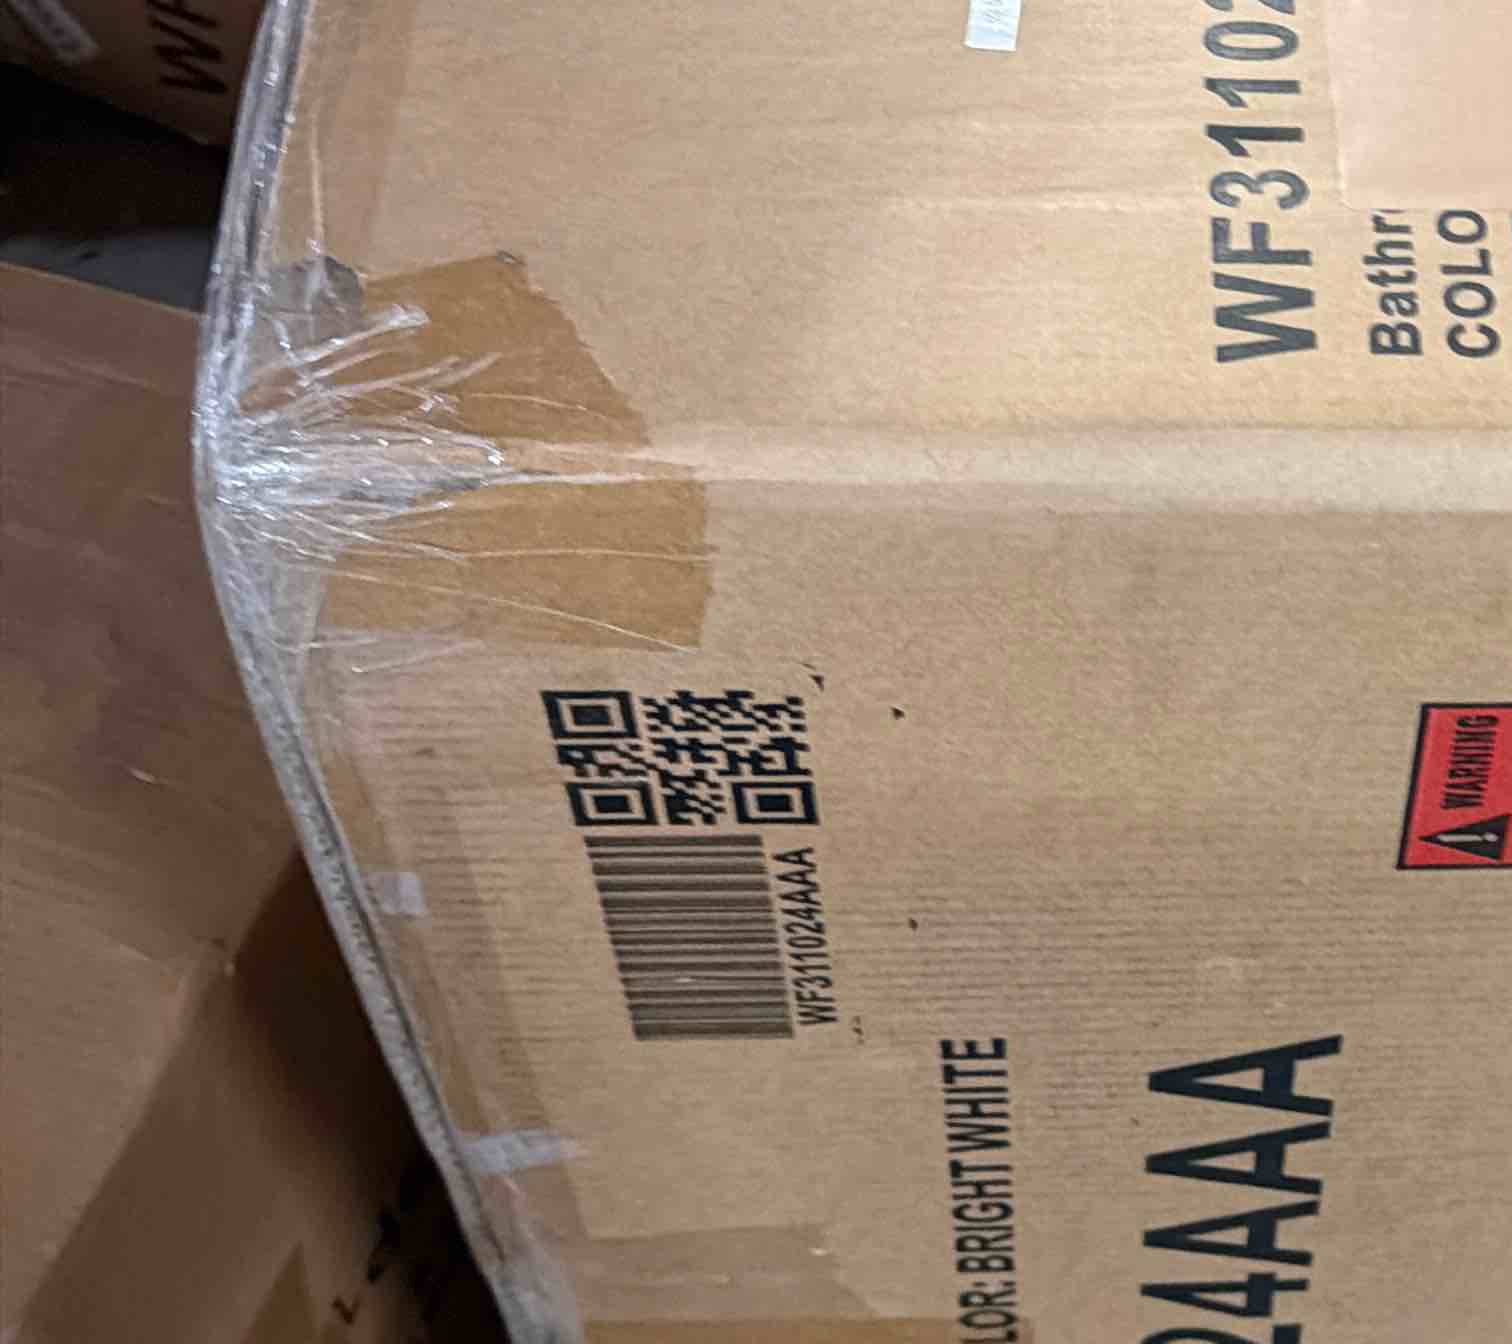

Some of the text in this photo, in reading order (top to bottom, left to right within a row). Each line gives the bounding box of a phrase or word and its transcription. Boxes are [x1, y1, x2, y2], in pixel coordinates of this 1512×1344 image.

[1363, 207, 1424, 356] Bathr
[1440, 715, 1500, 810] WARNING
[772, 846, 838, 1027] WF311024AAA
[939, 1037, 1011, 1154] WHITE
[950, 1160, 1018, 1275] BRIGHT
